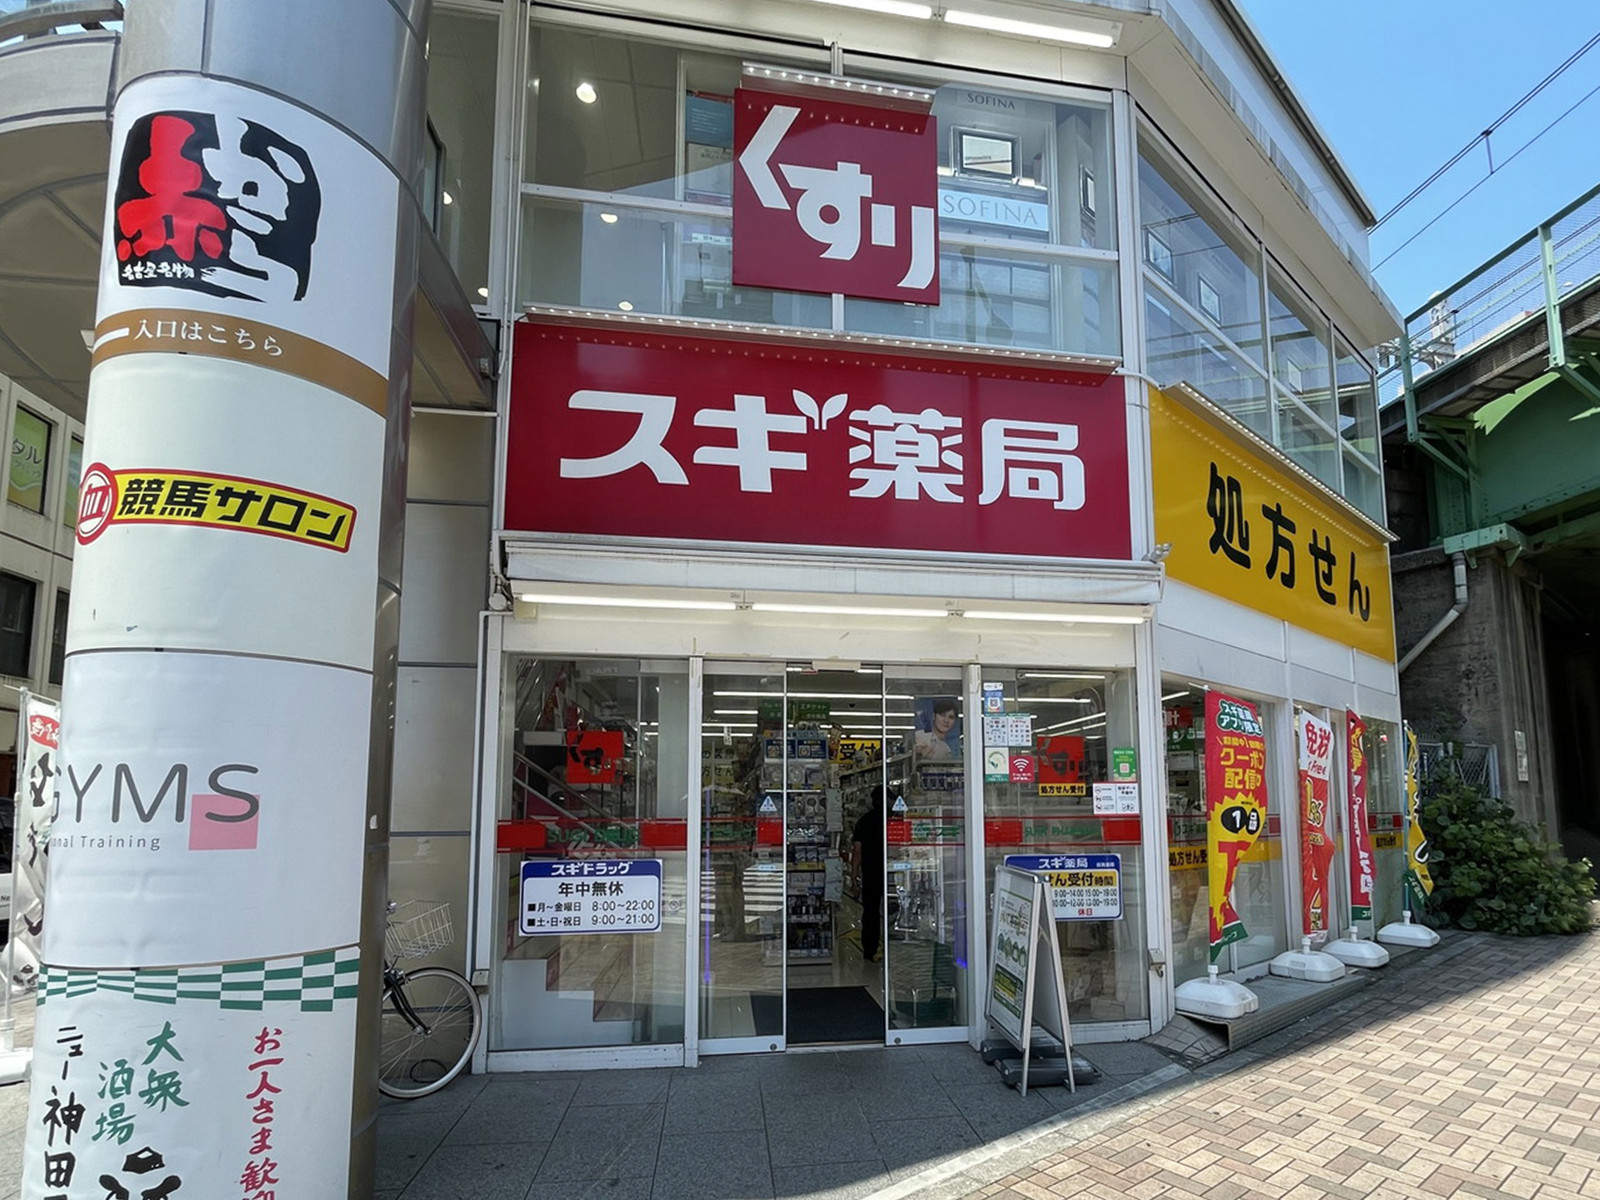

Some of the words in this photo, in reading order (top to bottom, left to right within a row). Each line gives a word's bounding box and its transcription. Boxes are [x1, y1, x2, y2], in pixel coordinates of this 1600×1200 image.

[967, 93, 1016, 111] SOFINA
[738, 105, 935, 290] くすり
[943, 194, 1038, 226] SOFINA
[133, 319, 283, 356] 入口はこちら
[560, 389, 1086, 511] スギ薬局
[117, 477, 346, 542] 競馬サロン
[1207, 461, 1371, 622] 処方せん
[1041, 784, 1084, 794] 処方せん受付
[80, 835, 161, 851] Training
[551, 862, 633, 876] スギドラッグ
[1038, 857, 1088, 869] スギ薬局
[558, 881, 623, 897] 年中無休
[591, 901, 655, 912] 8:00〜22:00
[591, 913, 655, 925] 9:00〜21:00
[142, 1021, 190, 1113] 大衆
[43, 1026, 86, 1200] ニュー神田
[92, 1059, 137, 1145] 酒場
[240, 1026, 285, 1200] お一人さま歓
